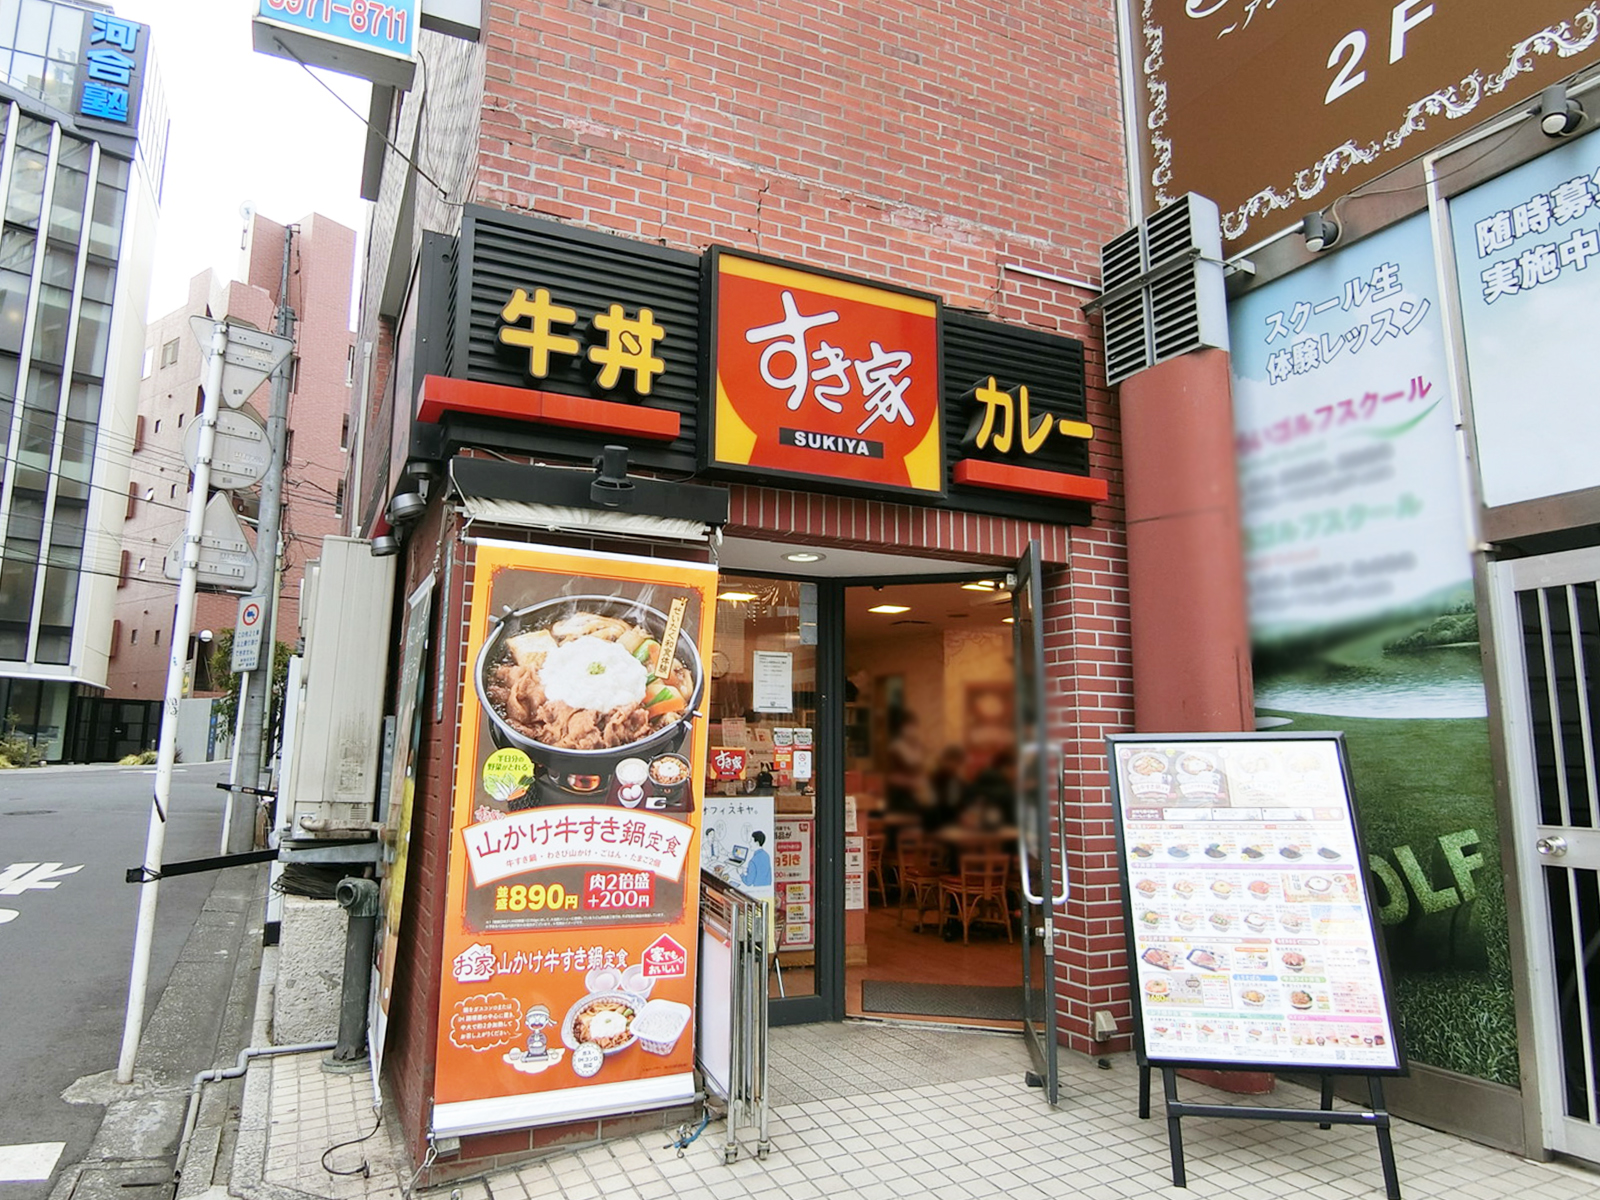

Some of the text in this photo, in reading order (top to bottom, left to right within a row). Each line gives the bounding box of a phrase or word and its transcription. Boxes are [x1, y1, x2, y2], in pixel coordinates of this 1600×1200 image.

[80, 12, 140, 122] 河合塾
[1475, 166, 1600, 259] 随時募
[498, 287, 667, 397] 牛丼
[1264, 262, 1402, 345] スクール生
[1265, 298, 1431, 385] 体験レッスン
[745, 290, 916, 435] すき家
[793, 430, 870, 457] SUKIYA
[975, 376, 1095, 455] カレー
[475, 815, 682, 859] 山かけ牛すき鍋定食
[587, 890, 650, 908] +200円
[589, 873, 651, 891] 肉2倍盛
